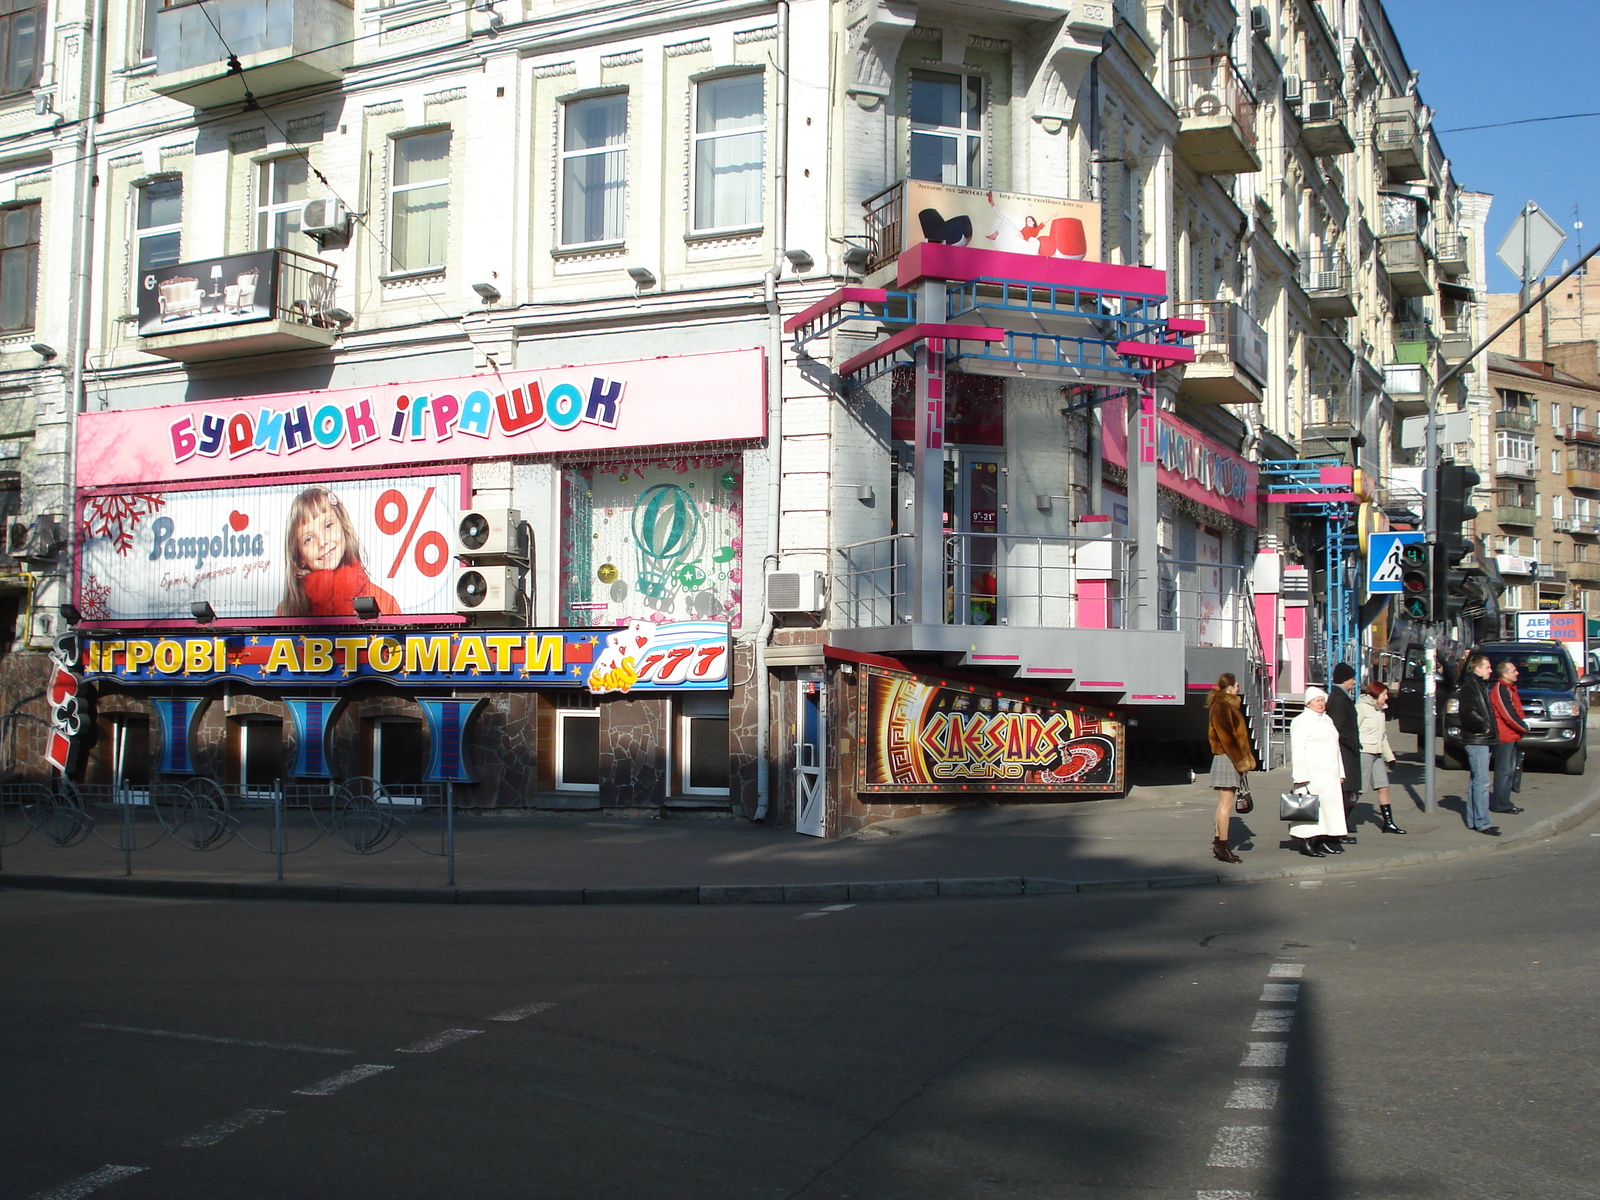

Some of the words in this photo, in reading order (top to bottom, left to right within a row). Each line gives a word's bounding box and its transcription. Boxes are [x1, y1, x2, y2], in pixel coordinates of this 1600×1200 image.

[169, 395, 381, 463] БУДИНОК
[149, 511, 265, 569] Pampolina
[1526, 618, 1575, 627] ДЕКОР
[1526, 629, 1577, 638] СЕРВІС
[89, 638, 228, 674] ІГРОВІ
[266, 634, 564, 673] АВТОМАТИ
[920, 712, 1068, 765] CAESARS
[933, 763, 1024, 778] CASINO
